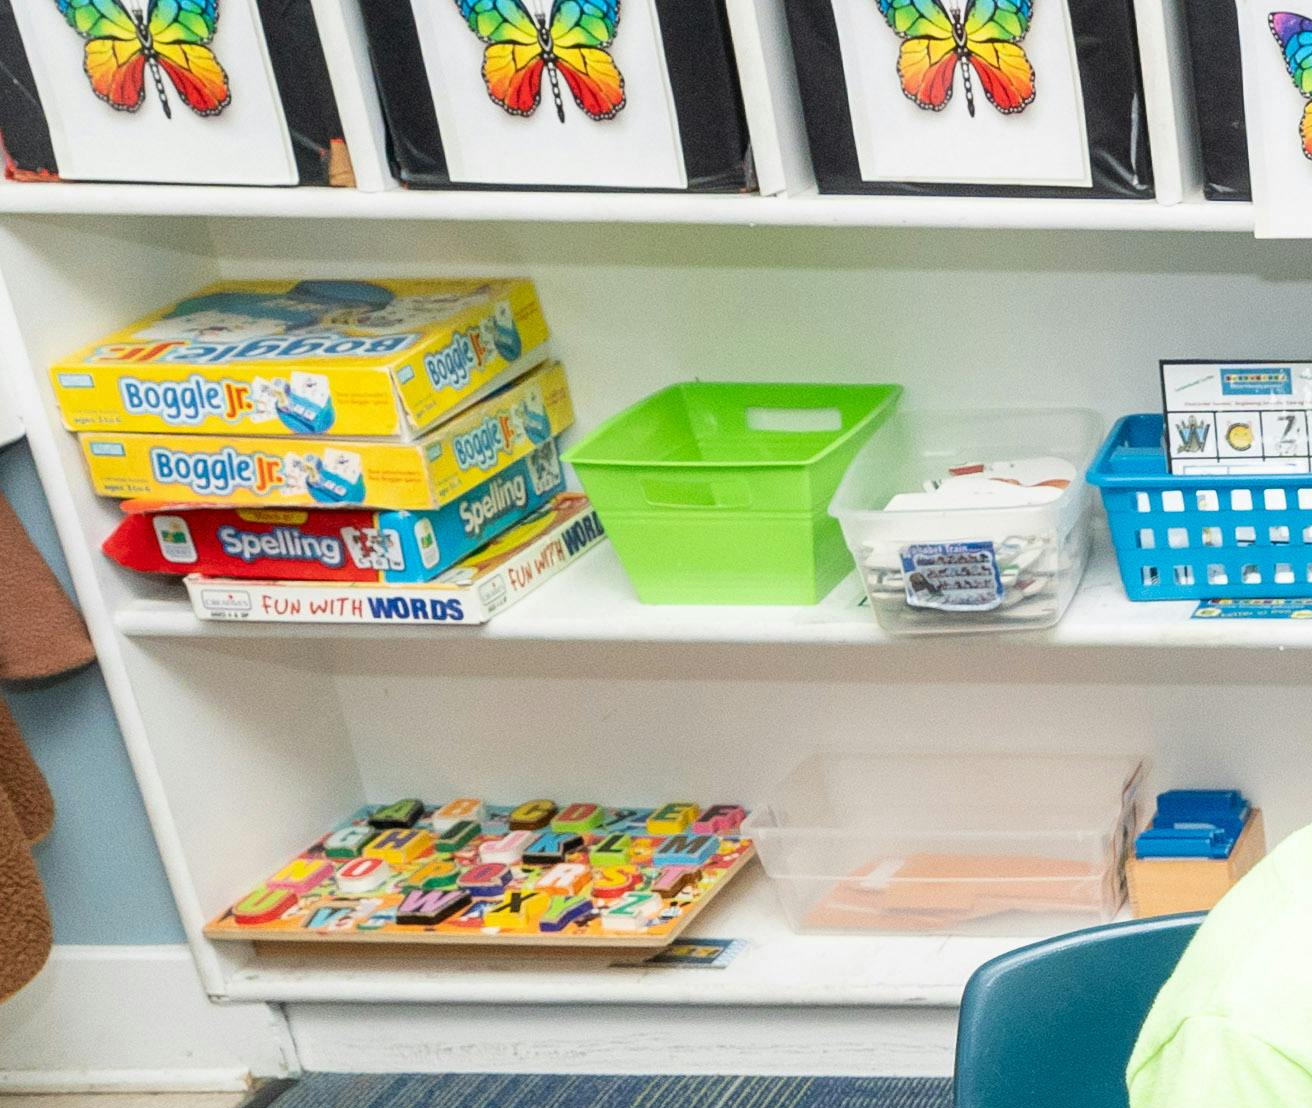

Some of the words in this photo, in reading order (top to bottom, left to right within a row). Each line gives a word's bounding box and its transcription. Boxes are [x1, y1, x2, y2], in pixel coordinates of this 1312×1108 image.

[173, 335, 412, 363] Boggle
[427, 335, 474, 387] Boggle
[124, 376, 222, 420] Boggle
[224, 382, 254, 419] Jr.
[455, 417, 502, 465] Boggle
[155, 451, 252, 497] Boggle
[254, 455, 284, 493] Jr.
[459, 473, 528, 535] Spelling
[223, 526, 343, 567] Spelling
[508, 566, 534, 592] FUN
[535, 540, 565, 576] WITH
[262, 595, 301, 616] FUN
[309, 597, 364, 619] WITH
[368, 597, 465, 622] WORDS
[594, 865, 641, 896] S
[397, 890, 471, 922] W
